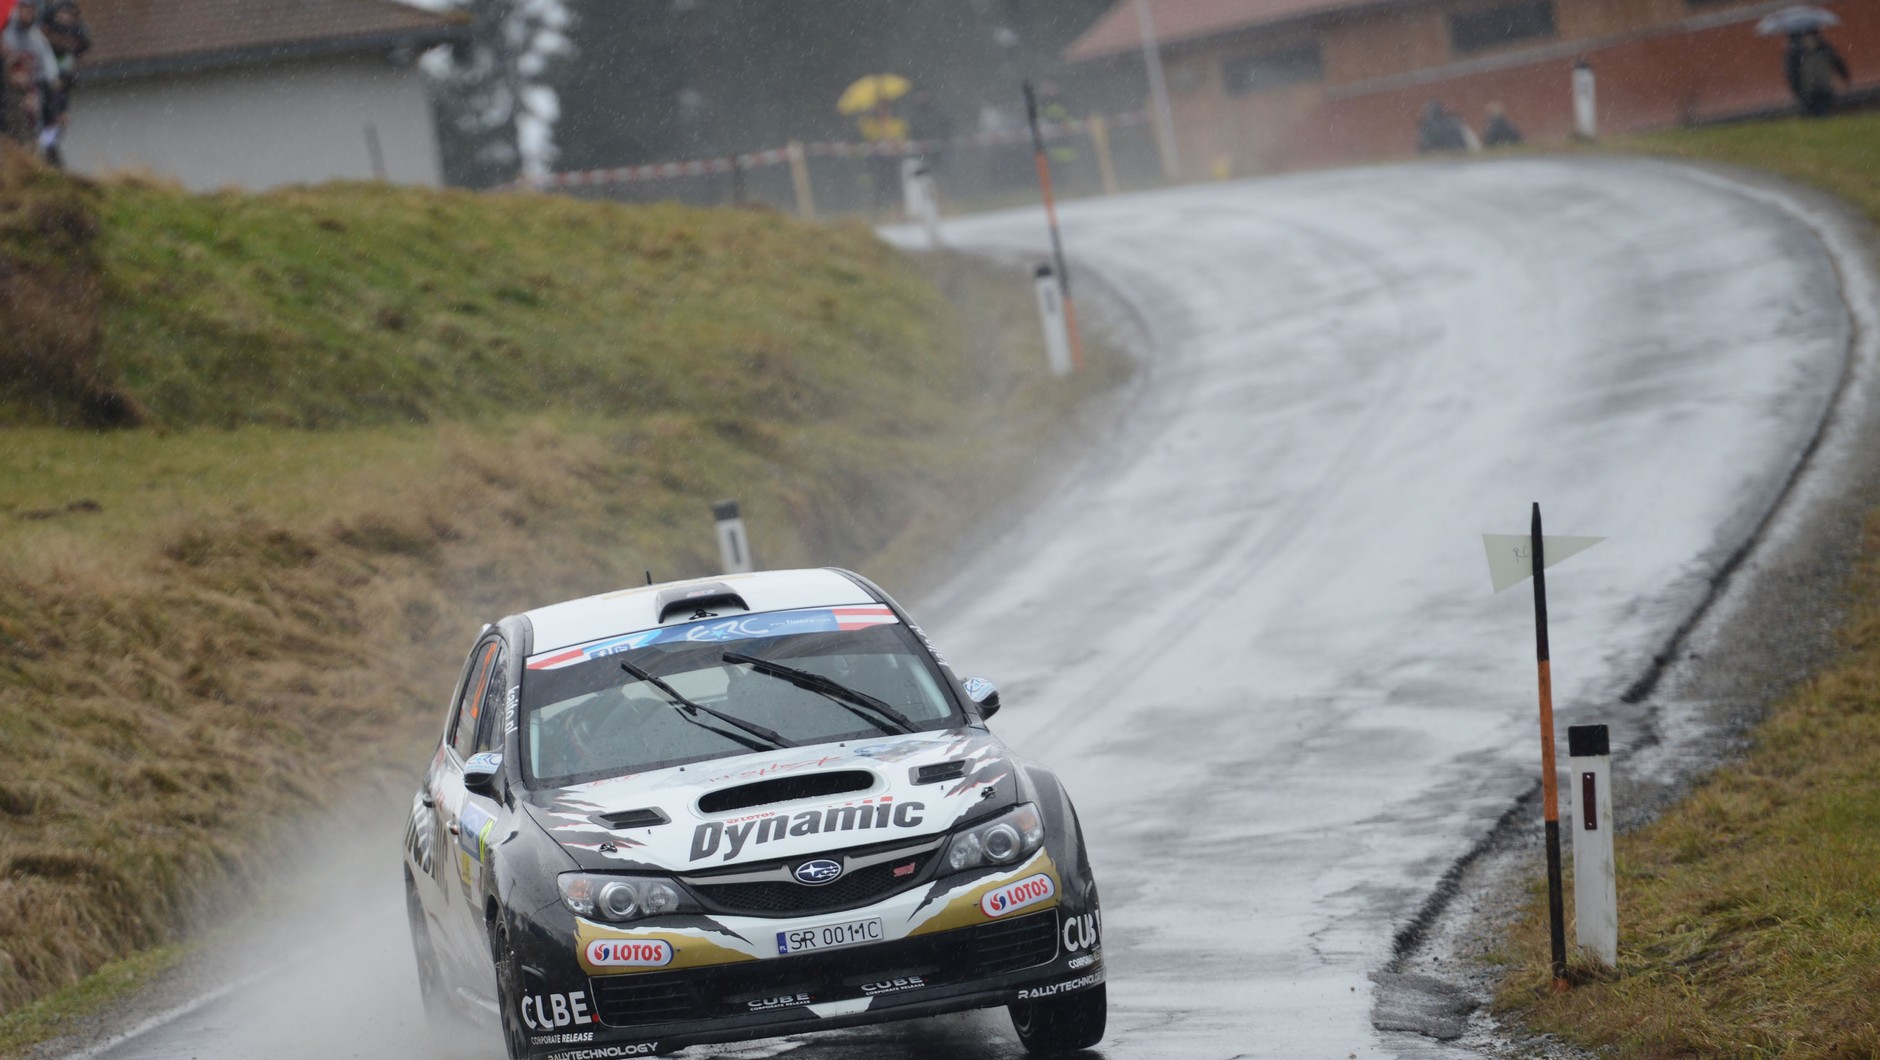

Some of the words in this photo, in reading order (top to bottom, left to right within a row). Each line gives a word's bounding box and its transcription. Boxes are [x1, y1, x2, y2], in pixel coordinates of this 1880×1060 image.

[689, 796, 926, 862] Dynamic
[740, 811, 776, 822] LOTOS
[1006, 878, 1049, 906] LOTOS
[789, 930, 816, 950] SR
[823, 921, 879, 945] 0011C
[1063, 909, 1103, 952] CUB
[613, 944, 663, 961] LOTOS
[530, 1034, 561, 1045] CORPORATE
[561, 1032, 594, 1043] RELEASE
